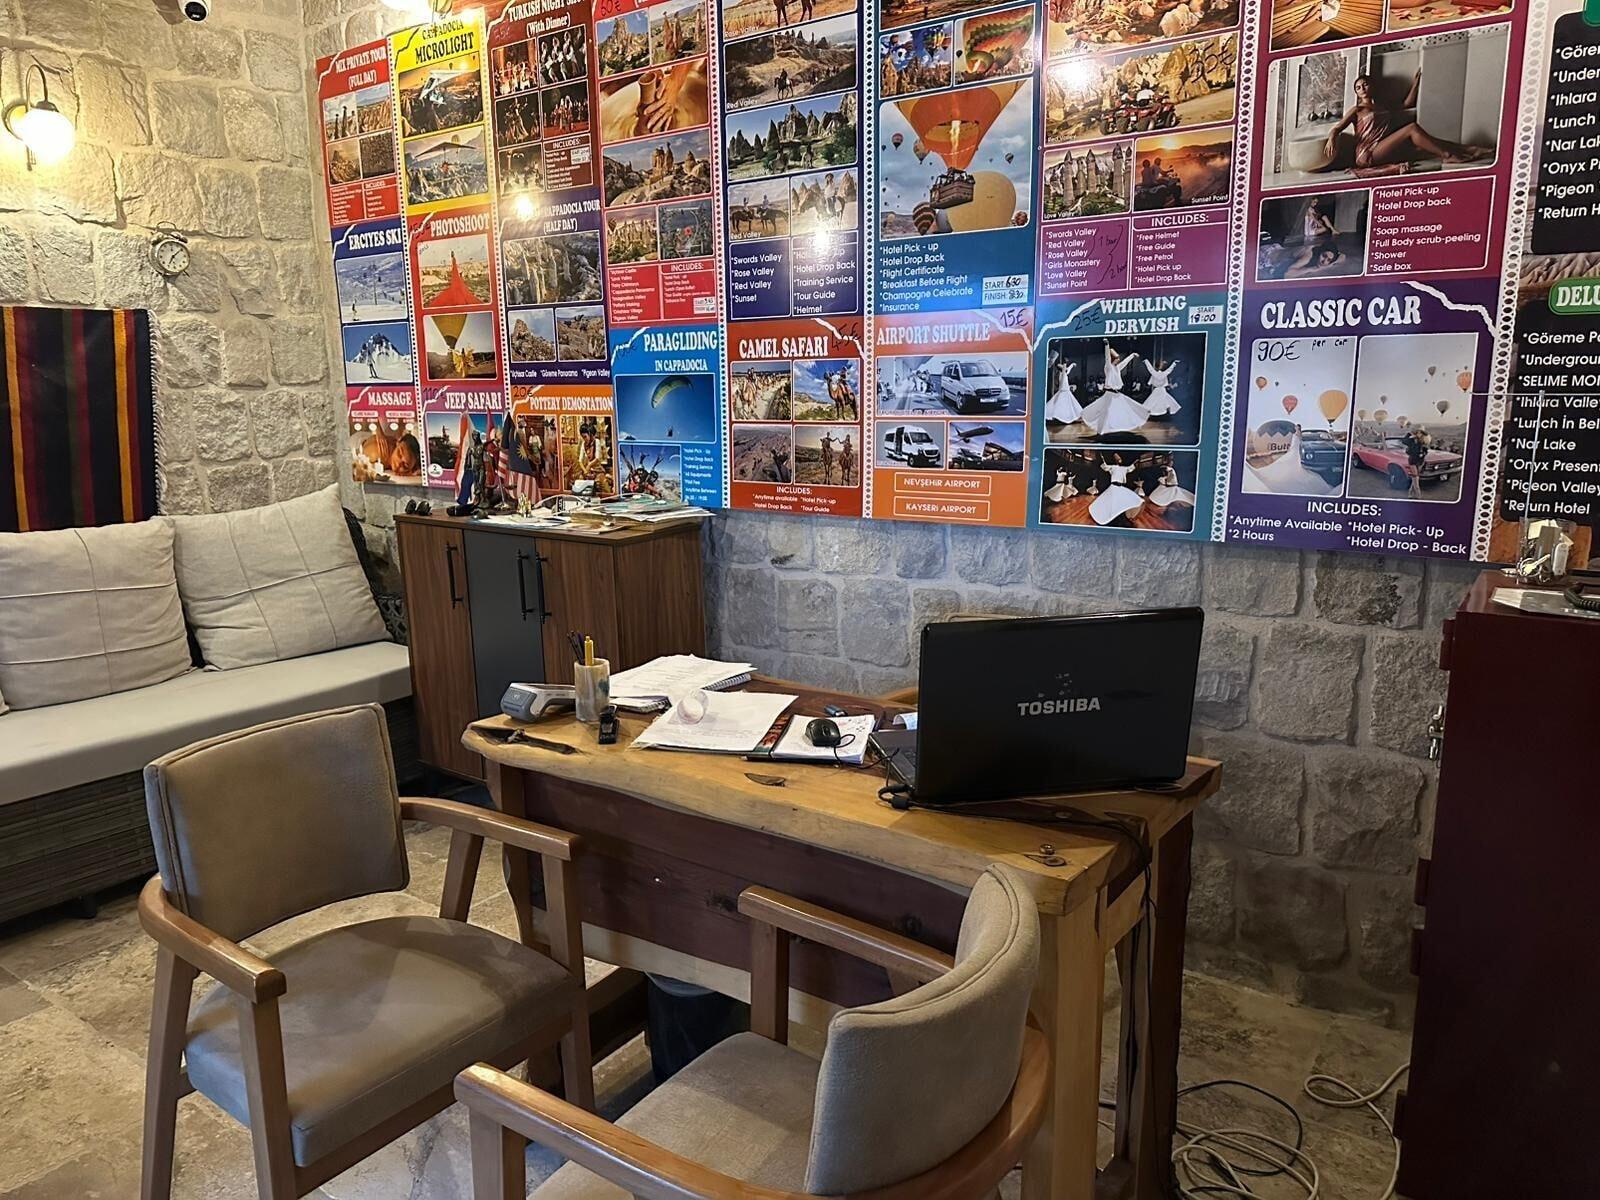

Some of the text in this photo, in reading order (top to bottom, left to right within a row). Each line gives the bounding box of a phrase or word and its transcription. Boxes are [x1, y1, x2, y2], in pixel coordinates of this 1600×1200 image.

[508, 0, 540, 22] TURKISH
[415, 31, 474, 64] MICROLIGHT
[1555, 91, 1597, 106] Ihlara
[1553, 113, 1596, 129] Lunch
[1550, 139, 1577, 152] Nar
[1548, 161, 1586, 175] Onyx
[1379, 186, 1439, 199] Hotel Pick-up
[1545, 183, 1594, 199] Pigeon
[1378, 197, 1451, 211] Hotel Drop back
[1376, 214, 1405, 223] Sauna
[1543, 205, 1587, 219] Return
[430, 213, 490, 238] PHOTOSHOOT
[1151, 213, 1209, 227] INCLUDES:
[1048, 228, 1097, 239] Swords Valley
[1139, 231, 1180, 241] Free Helmet
[1375, 223, 1443, 236] Soap massage
[348, 230, 385, 250] ERCIYES
[385, 227, 402, 245] SKI
[1048, 239, 1086, 249] Red Valley
[1375, 232, 1481, 248] Full Body scrub-peeling
[882, 243, 939, 255] Hotel Pick up
[1154, 242, 1175, 250] Guide
[733, 253, 782, 265] Swords Valley
[882, 253, 945, 266] Hotel Drop Back
[1048, 250, 1088, 259] Rose Valley
[1154, 253, 1173, 261] Petrol
[1373, 250, 1406, 260] Shower
[796, 260, 856, 273] Hotel Drop Back
[1064, 259, 1101, 268] Monastery
[1137, 263, 1182, 273] Hotel Pick up
[1372, 261, 1412, 272] Safe box
[734, 267, 775, 278] Rose Valley
[882, 265, 945, 279] Flight Certificate
[1065, 270, 1087, 278] Valley
[1137, 273, 1191, 283] Hotel Drop Back
[734, 280, 772, 290] Red Valley
[796, 275, 854, 287] Training Service
[882, 275, 968, 290] Breakfast Before Flight
[1046, 281, 1069, 289] Sunset
[734, 294, 757, 303] Sunset
[796, 290, 836, 301] Tour Guide
[882, 287, 973, 301] Champagne Celebrate
[796, 305, 823, 314] Helmet
[882, 303, 920, 312] Insurance
[1100, 295, 1187, 314] WHIRLING
[1000, 308, 1029, 328] 15€
[1260, 295, 1422, 330] CLASSIC CAR
[1104, 317, 1179, 335] DERVISH
[876, 322, 991, 345] AIRPORT SHUTTLE
[1527, 332, 1585, 344] Göreme
[643, 331, 718, 352] PARAGLIDING
[739, 336, 829, 359] CAMEL SAFARI
[1257, 340, 1300, 361] 90€
[654, 358, 708, 372] IN CAPPADOCIA
[1525, 353, 1600, 368] Undergrou
[1522, 374, 1568, 387] SELIME
[367, 391, 413, 406] MASSAGE
[444, 392, 466, 409] JEEP
[467, 391, 502, 410] SAFARI
[530, 396, 613, 411] POTTERY DEMOSTATION
[1563, 396, 1600, 409] Valle
[1543, 438, 1577, 450] Lake
[1513, 458, 1549, 473] Onyx
[776, 486, 812, 495] INCLUDES:
[944, 480, 980, 488] AIRPORT
[940, 505, 976, 514] AIRPORT
[1307, 501, 1382, 517] INCLUDES:
[1508, 499, 1591, 515] Reurn Hotel
[1233, 515, 1343, 532] Anytime Available
[1352, 521, 1386, 533] Hotel
[1426, 526, 1445, 539] Up
[1232, 529, 1275, 541] 2 Hours
[1350, 536, 1467, 555] Hotel Drop Back
[1017, 697, 1101, 716] TOSHIBA
